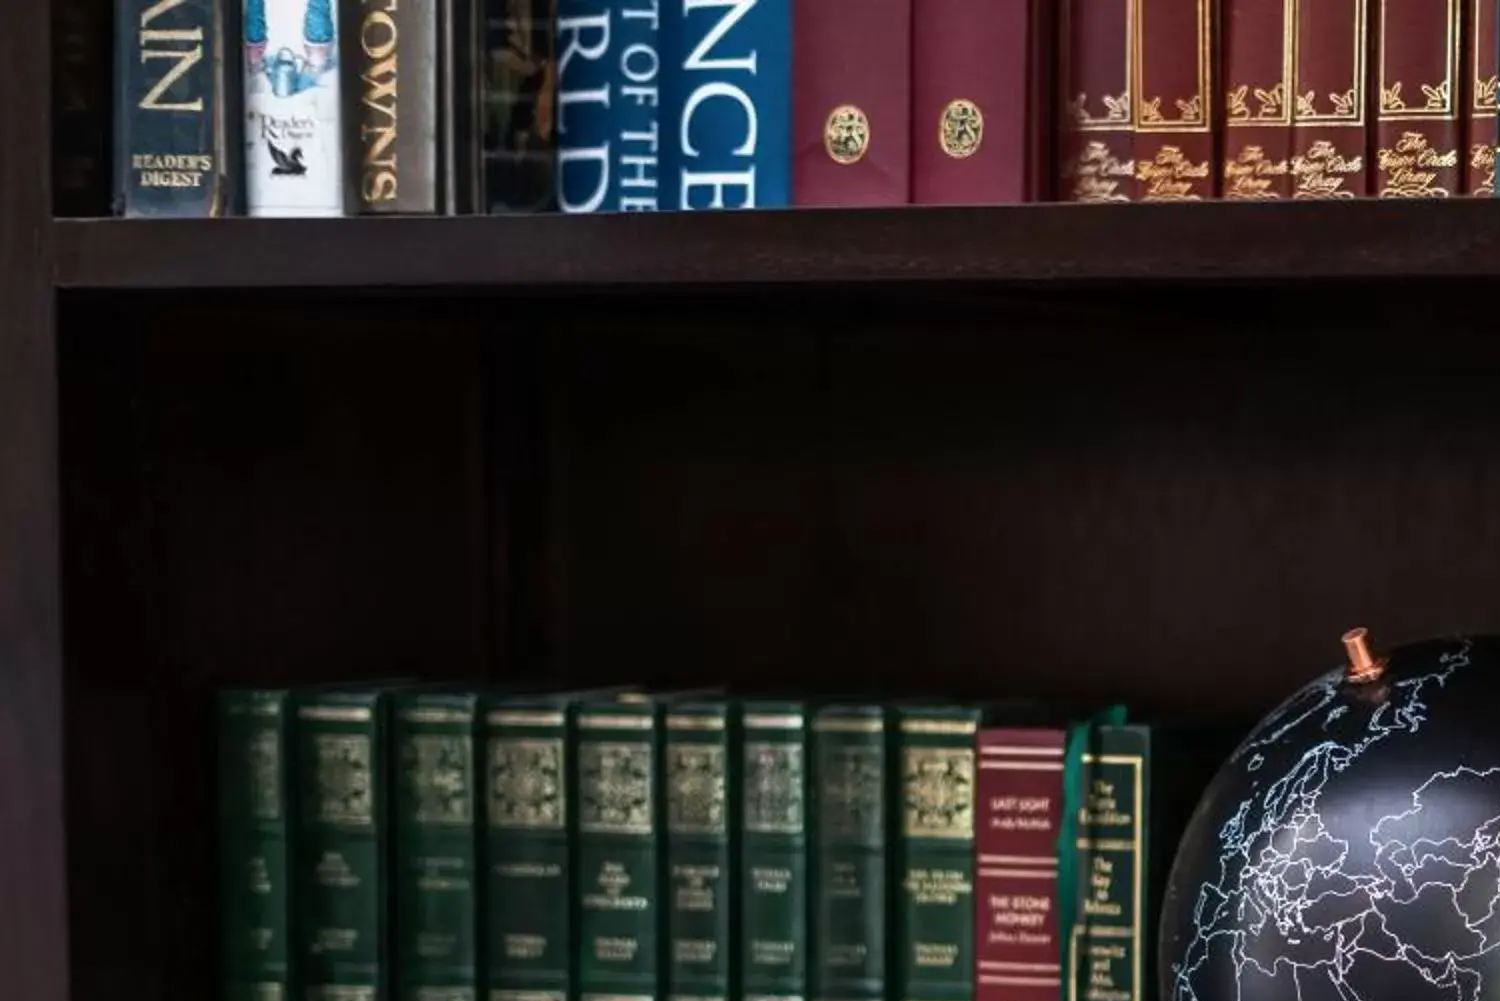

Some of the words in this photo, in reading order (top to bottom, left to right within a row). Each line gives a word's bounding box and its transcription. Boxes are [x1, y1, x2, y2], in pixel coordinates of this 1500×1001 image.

[620, 43, 659, 107] OF
[132, 153, 212, 169] READER'S
[140, 171, 203, 188] DIGEST
